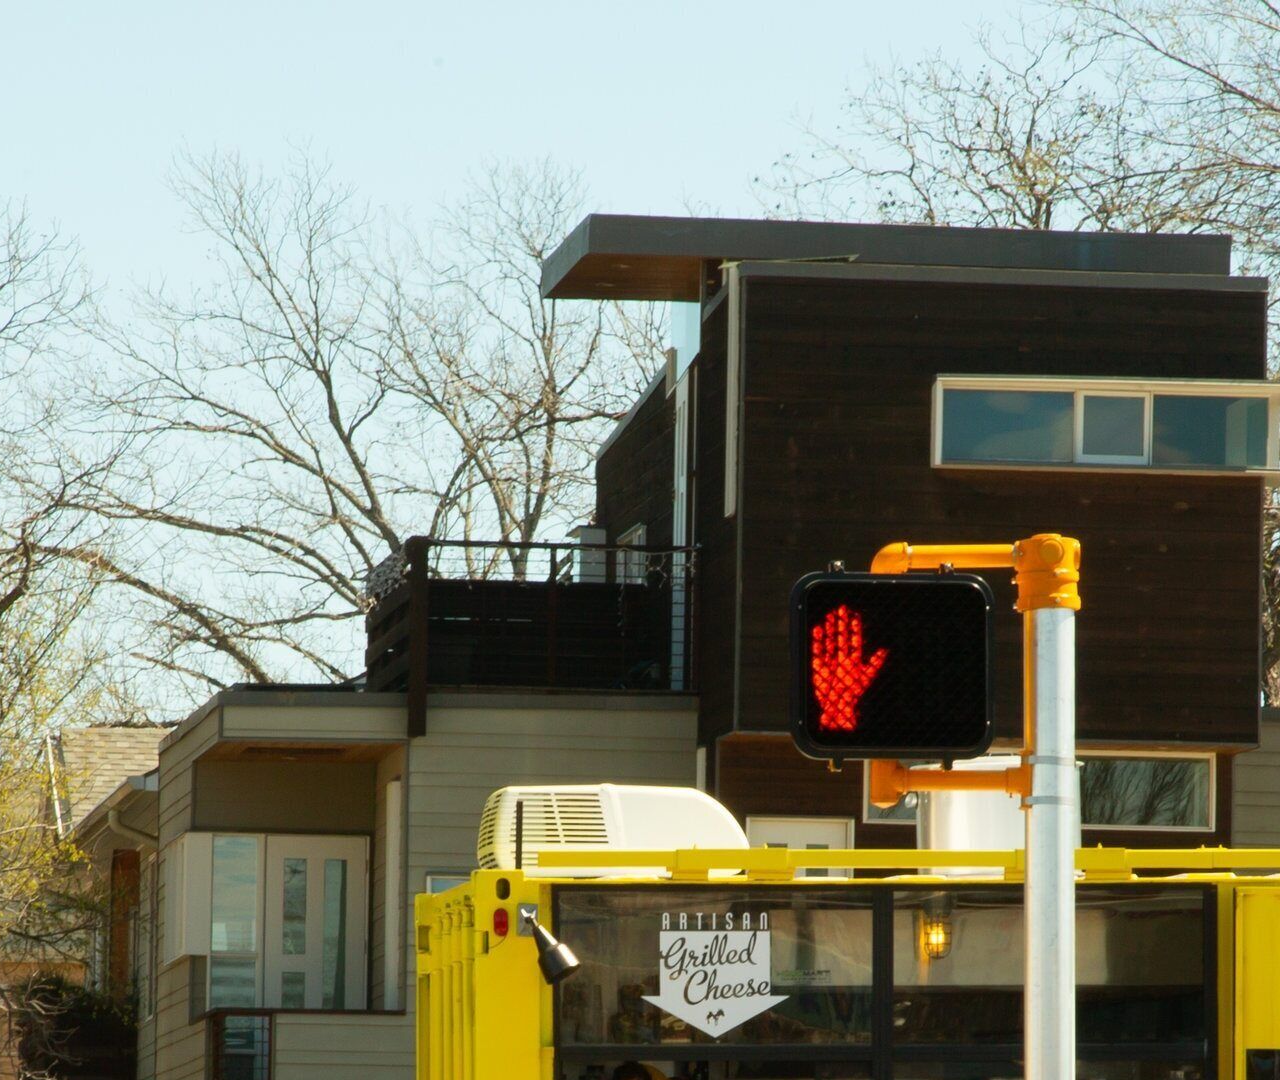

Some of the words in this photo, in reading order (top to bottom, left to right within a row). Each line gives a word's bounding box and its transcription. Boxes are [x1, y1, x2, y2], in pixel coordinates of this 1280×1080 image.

[661, 911, 768, 931] ARTISAN
[659, 931, 758, 980] Grilled
[683, 968, 771, 1006] Cheese
